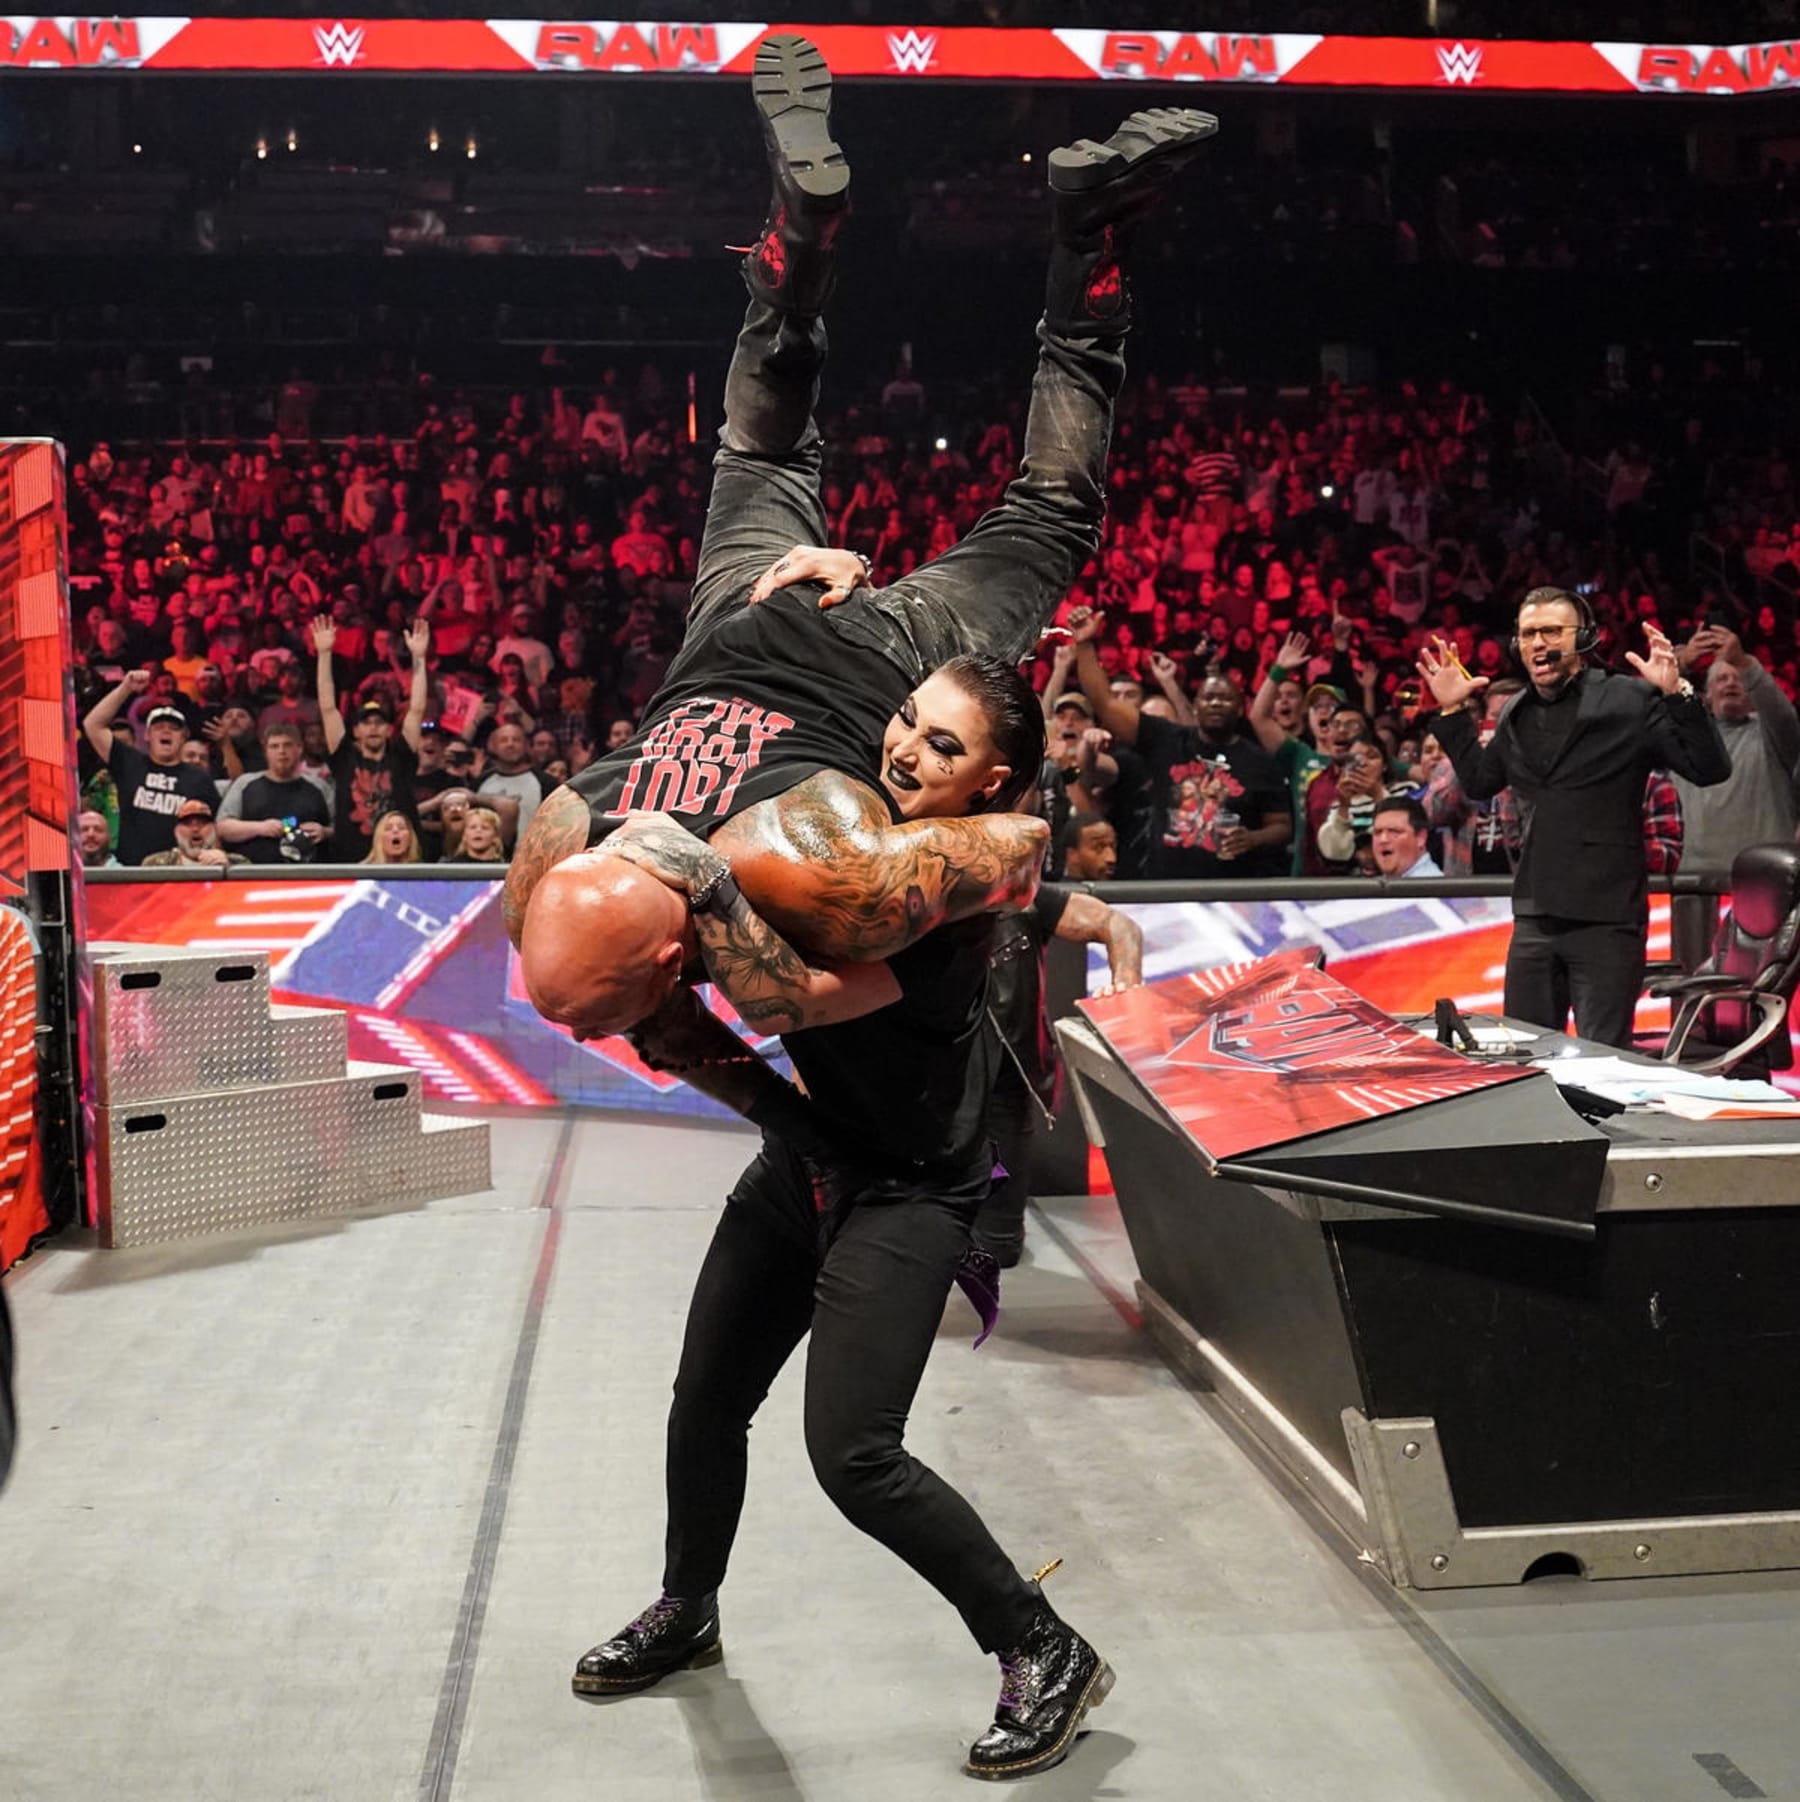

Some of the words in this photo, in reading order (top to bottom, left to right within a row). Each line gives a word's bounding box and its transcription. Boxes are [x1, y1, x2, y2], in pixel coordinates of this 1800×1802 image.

[534, 23, 720, 71] RAW
[1101, 32, 1278, 80] RAW
[1638, 39, 1800, 93] RAW
[132, 785, 188, 816] READY
[145, 772, 179, 791] GET
